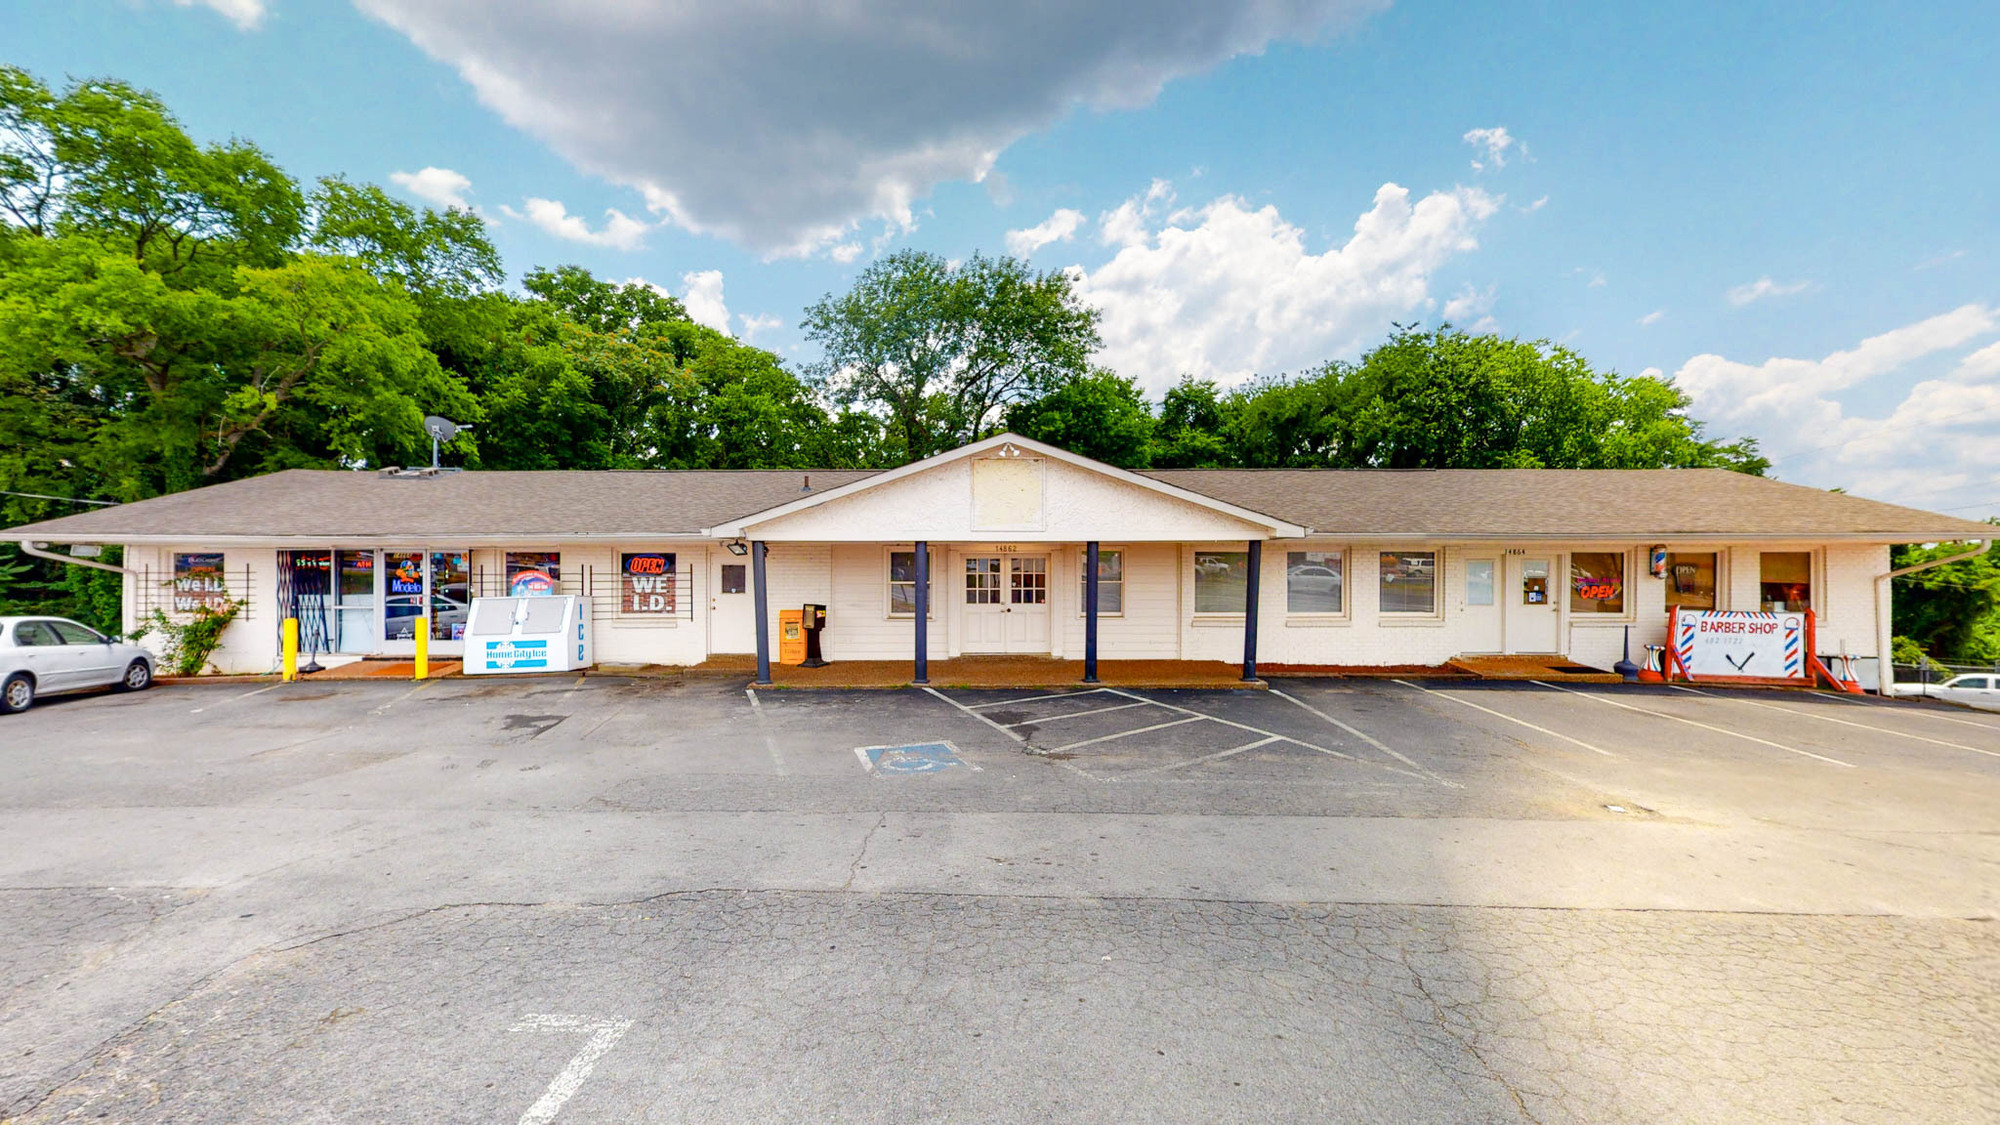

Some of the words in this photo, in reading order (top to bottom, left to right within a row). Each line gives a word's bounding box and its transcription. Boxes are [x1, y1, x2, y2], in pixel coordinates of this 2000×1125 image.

[631, 557, 665, 574] OPEN
[392, 579, 422, 593] Modelo
[632, 577, 667, 593] WE
[1580, 585, 1615, 600] OPEN
[633, 594, 673, 612] I.D.
[1700, 620, 1745, 634] BARBER
[1748, 622, 1778, 635] SHOP
[486, 650, 513, 659] Home
[514, 649, 531, 660] City
[532, 648, 547, 658] Ice
